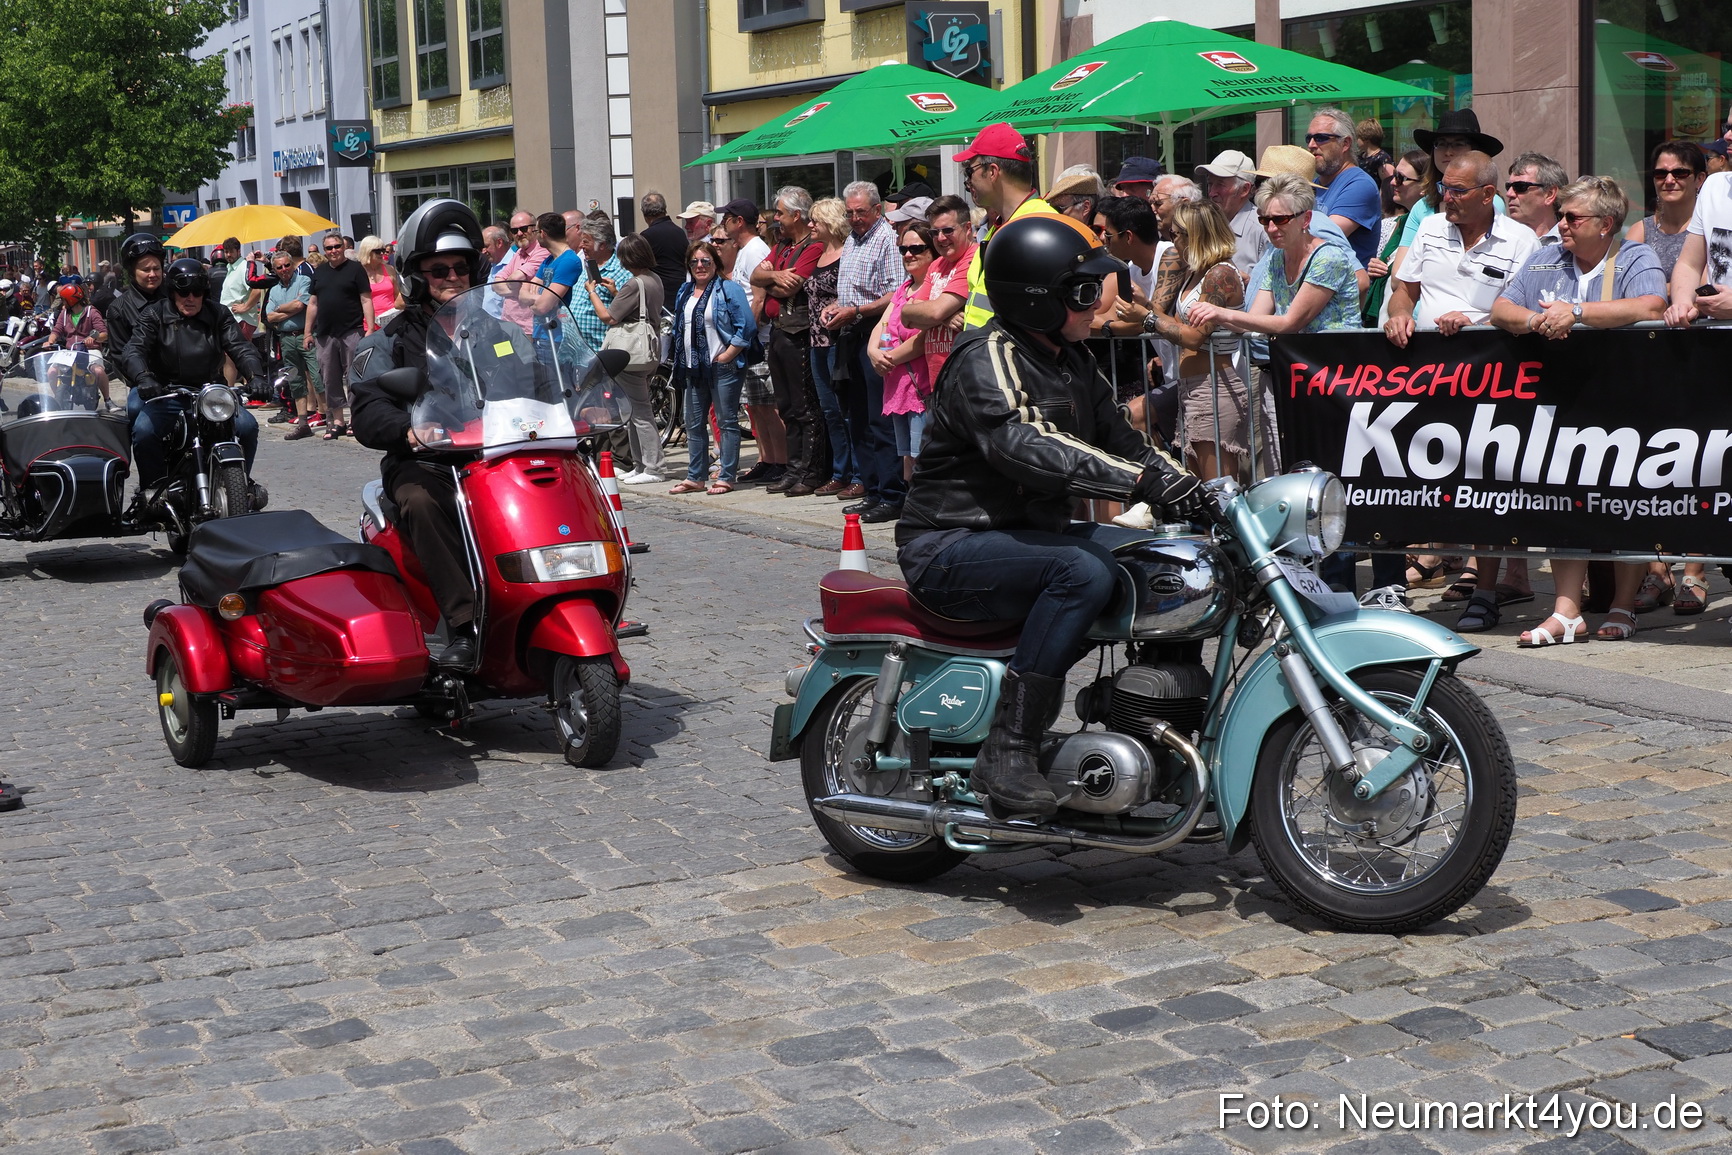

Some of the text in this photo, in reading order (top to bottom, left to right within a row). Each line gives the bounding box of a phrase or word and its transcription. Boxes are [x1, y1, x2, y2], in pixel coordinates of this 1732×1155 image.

[942, 26, 970, 62] G2
[1204, 82, 1341, 99] Lammsbräu
[1210, 75, 1307, 87] Neumarkter
[977, 101, 1080, 123] Lammsbräu
[1290, 361, 1544, 400] FAHRSCHULE
[1454, 485, 1572, 515] Burgthann
[1587, 492, 1698, 521] Freystadt
[1713, 492, 1732, 522] P
